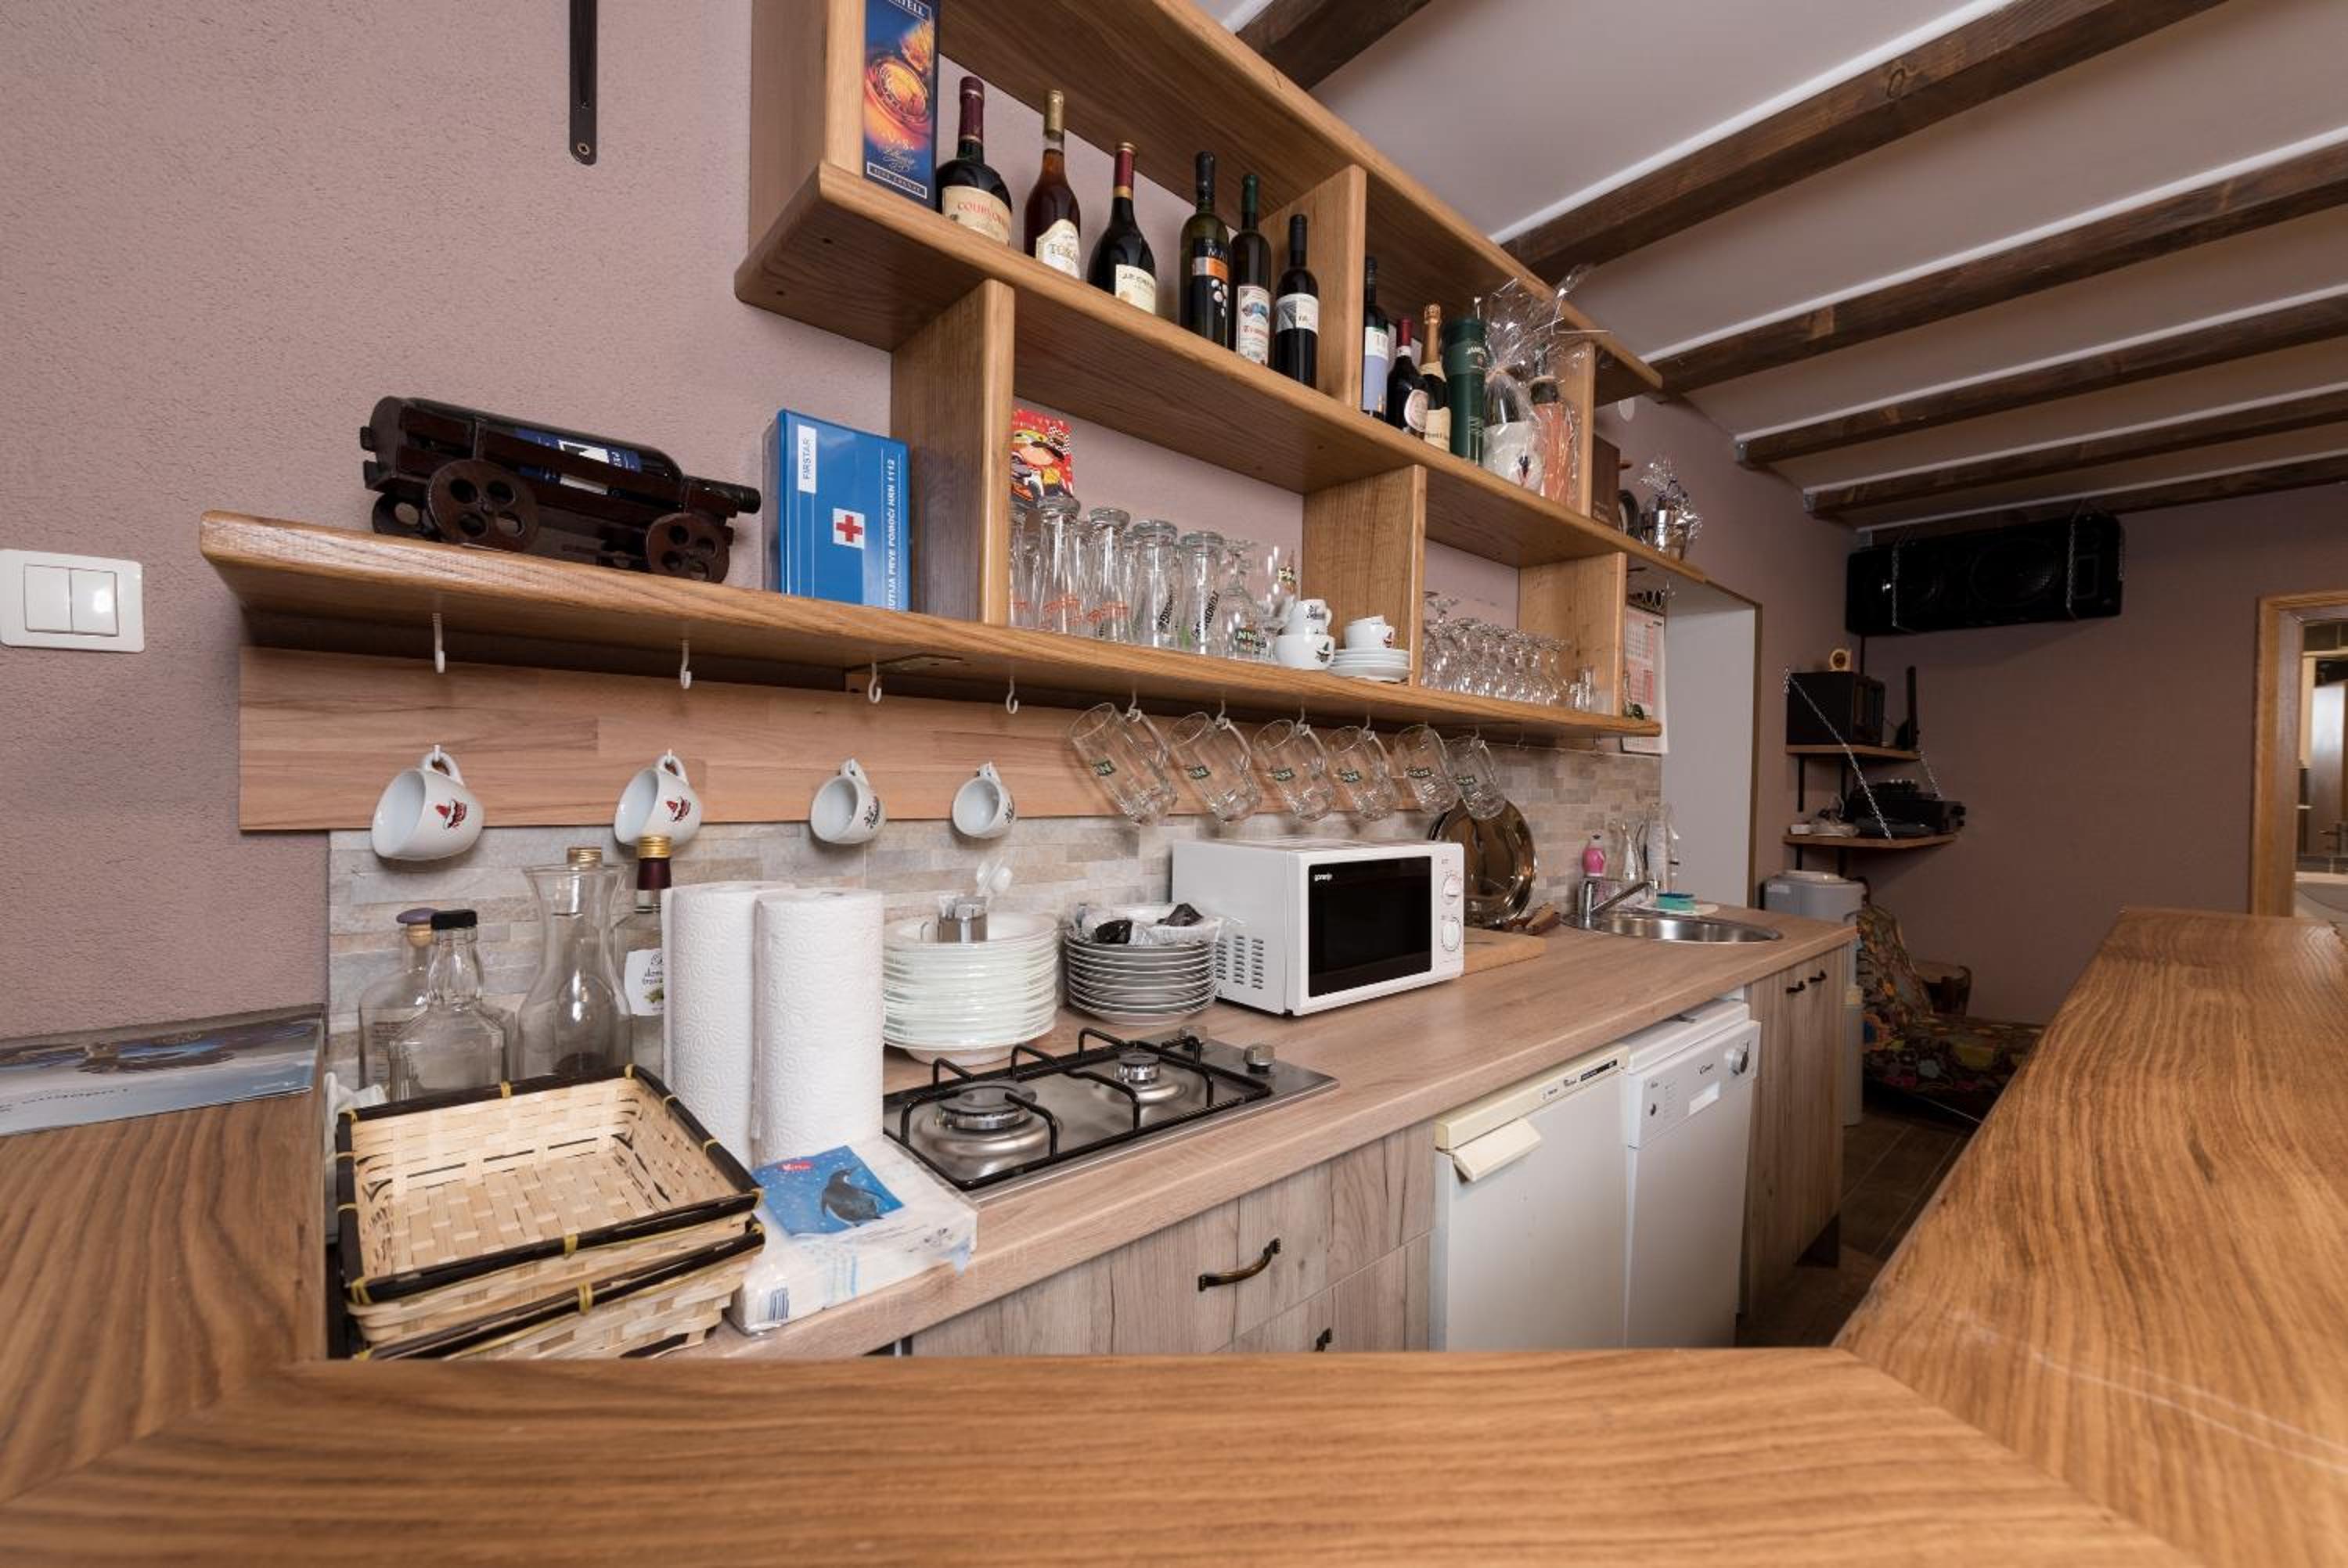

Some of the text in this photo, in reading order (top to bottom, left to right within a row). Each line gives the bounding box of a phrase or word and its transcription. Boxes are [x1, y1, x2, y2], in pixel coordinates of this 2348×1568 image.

[802, 437, 811, 480] FIRSTAR
[887, 459, 896, 481] 1112
[887, 485, 895, 506] HRN
[887, 549, 896, 574] PRVE
